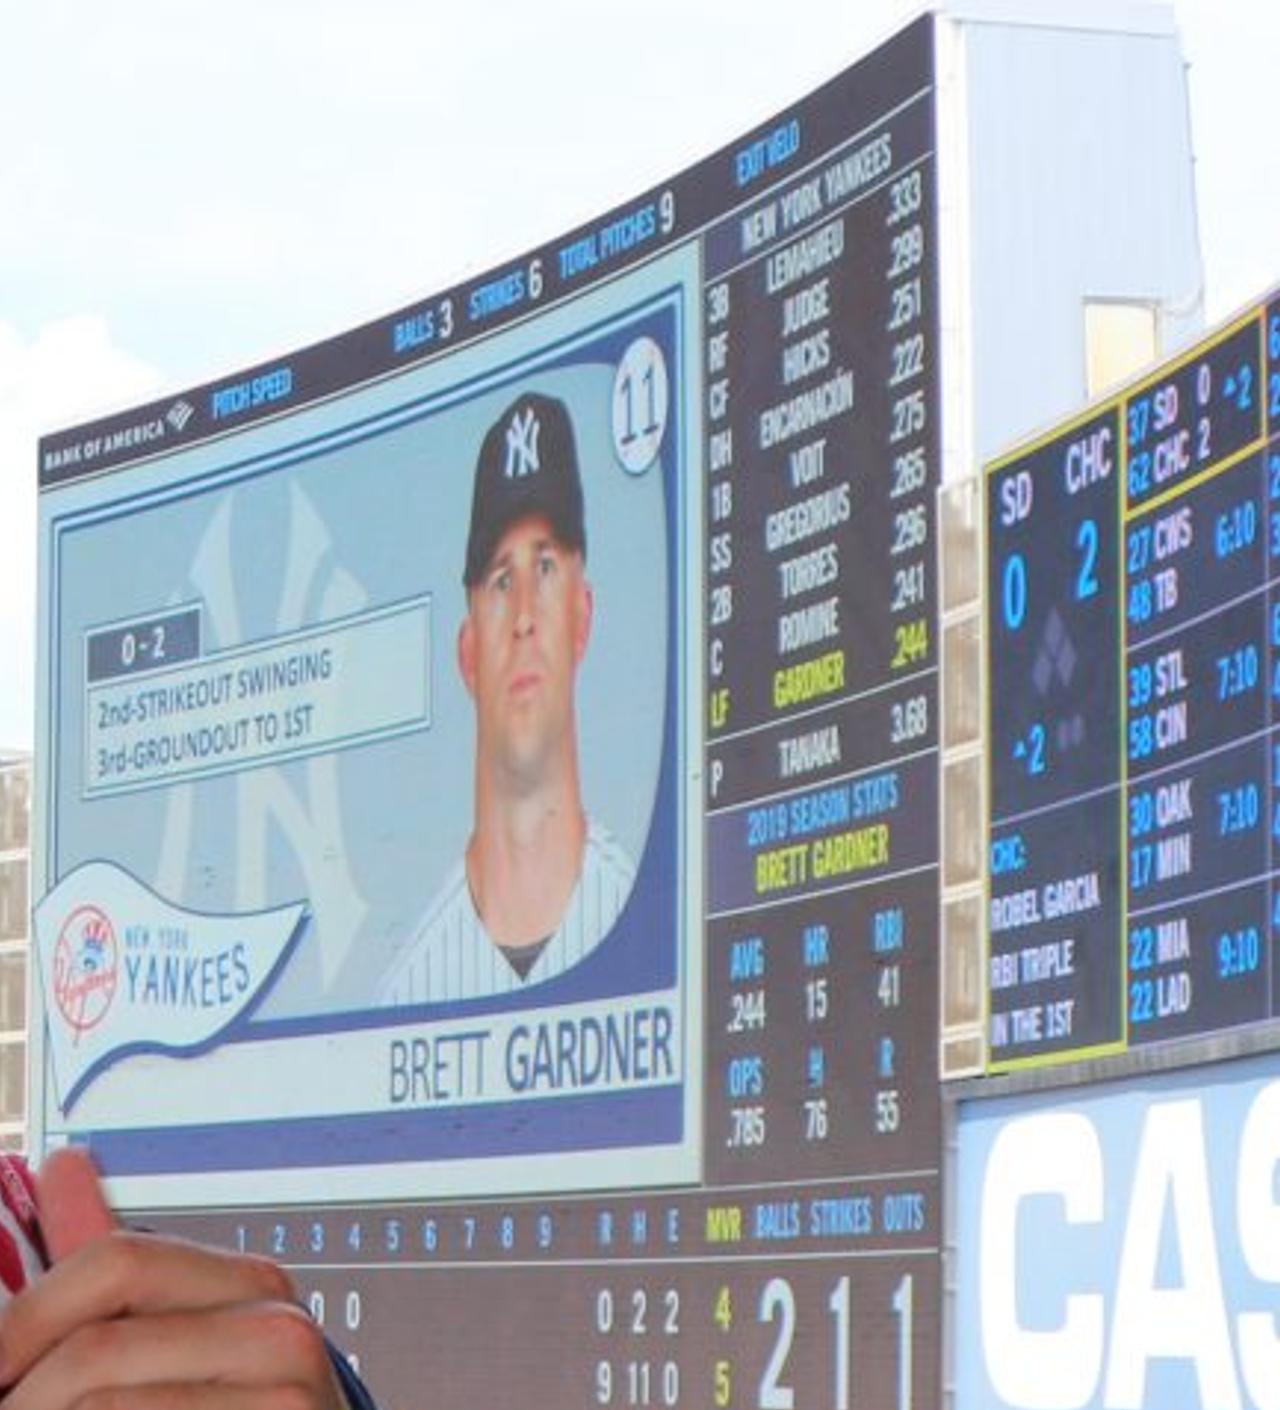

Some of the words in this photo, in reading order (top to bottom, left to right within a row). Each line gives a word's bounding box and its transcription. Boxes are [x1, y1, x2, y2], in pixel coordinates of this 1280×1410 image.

[742, 203, 777, 252] NEW
[781, 177, 822, 228] YORK
[826, 133, 891, 202] YANKEES
[559, 240, 599, 280] TOTAL
[601, 204, 655, 263] PITCHES
[661, 192, 674, 232] 9
[709, 284, 729, 324] 3B
[767, 218, 844, 294] LEMAHIEU
[394, 310, 434, 352] BALLS
[440, 301, 454, 338] 3
[469, 269, 524, 321] STRIKES
[529, 259, 543, 298] 6
[710, 332, 728, 373] RF
[784, 279, 829, 336] JUDGE
[213, 376, 251, 419] PITCH
[253, 368, 292, 406] SPEED
[620, 365, 659, 445] 11
[710, 379, 728, 419] CF
[784, 330, 830, 385] HICKS
[44, 449, 81, 471] BANK
[84, 444, 101, 460] OF
[104, 418, 164, 452] AMERICA
[1129, 399, 1150, 446] 37
[1153, 384, 1178, 430] SD
[710, 428, 732, 471] DH
[711, 482, 732, 521] 1B
[792, 438, 826, 488] VOIT
[1002, 471, 1033, 526] SD
[1065, 428, 1113, 495] CHC
[1154, 429, 1190, 483] CHC
[711, 533, 732, 574] SS
[766, 482, 850, 551] GREGORIUS
[1128, 526, 1151, 574] 27
[1154, 507, 1192, 560] CWS
[1215, 501, 1256, 557] 6:10
[711, 586, 732, 625] 2B
[780, 543, 838, 598] TORRES
[1003, 555, 1028, 630] 0
[1076, 519, 1100, 600] 2
[1153, 567, 1178, 613] TB
[779, 597, 839, 653] ROMINE
[98, 672, 232, 730] 2nd-STRIKEOUT
[239, 650, 332, 700] SWINGING
[711, 688, 729, 728] LF
[774, 651, 844, 708] GARDNER
[1129, 663, 1152, 708] 39
[1155, 650, 1188, 696] STL
[1216, 645, 1258, 700] 7:10
[98, 720, 248, 779] 3rd-GROUNDOUT
[255, 714, 278, 743] TO
[284, 704, 315, 741] 1ST
[779, 726, 839, 777] TANAKA
[1155, 701, 1187, 749] CIN
[748, 804, 788, 846] 2019
[791, 785, 849, 835] SEASON
[853, 774, 898, 818] STATS
[1156, 777, 1192, 828] OAK
[1218, 783, 1258, 836] 7:10
[757, 844, 807, 894] BRETT
[813, 824, 888, 878] GARDNER
[1131, 844, 1152, 888] 17
[990, 889, 1041, 932] ROBEL
[1043, 872, 1101, 925] GARCIA
[124, 942, 249, 1007] YANKEES
[990, 953, 1019, 990] RBI
[1022, 940, 1075, 985] TRIPLE
[1130, 927, 1153, 971] 22
[1219, 927, 1259, 978] 9:10
[727, 990, 765, 1033] .244
[806, 980, 827, 1022] 15
[878, 966, 899, 1007] 41
[1011, 1006, 1042, 1043] THE
[1046, 1000, 1075, 1038] 1ST
[1131, 979, 1153, 1022] 22
[1157, 971, 1191, 1017] LAD
[390, 1029, 491, 1104] BRETT
[506, 1006, 674, 1092] GARDNER
[730, 1057, 762, 1097] OPS
[804, 1099, 827, 1140] 76
[877, 1090, 899, 1132] 55
[757, 1201, 800, 1239] BALLS
[811, 1196, 872, 1236] STRIKES
[884, 1194, 924, 1232] OUTS
[759, 1278, 796, 1410] 2
[629, 1361, 650, 1405] 11
